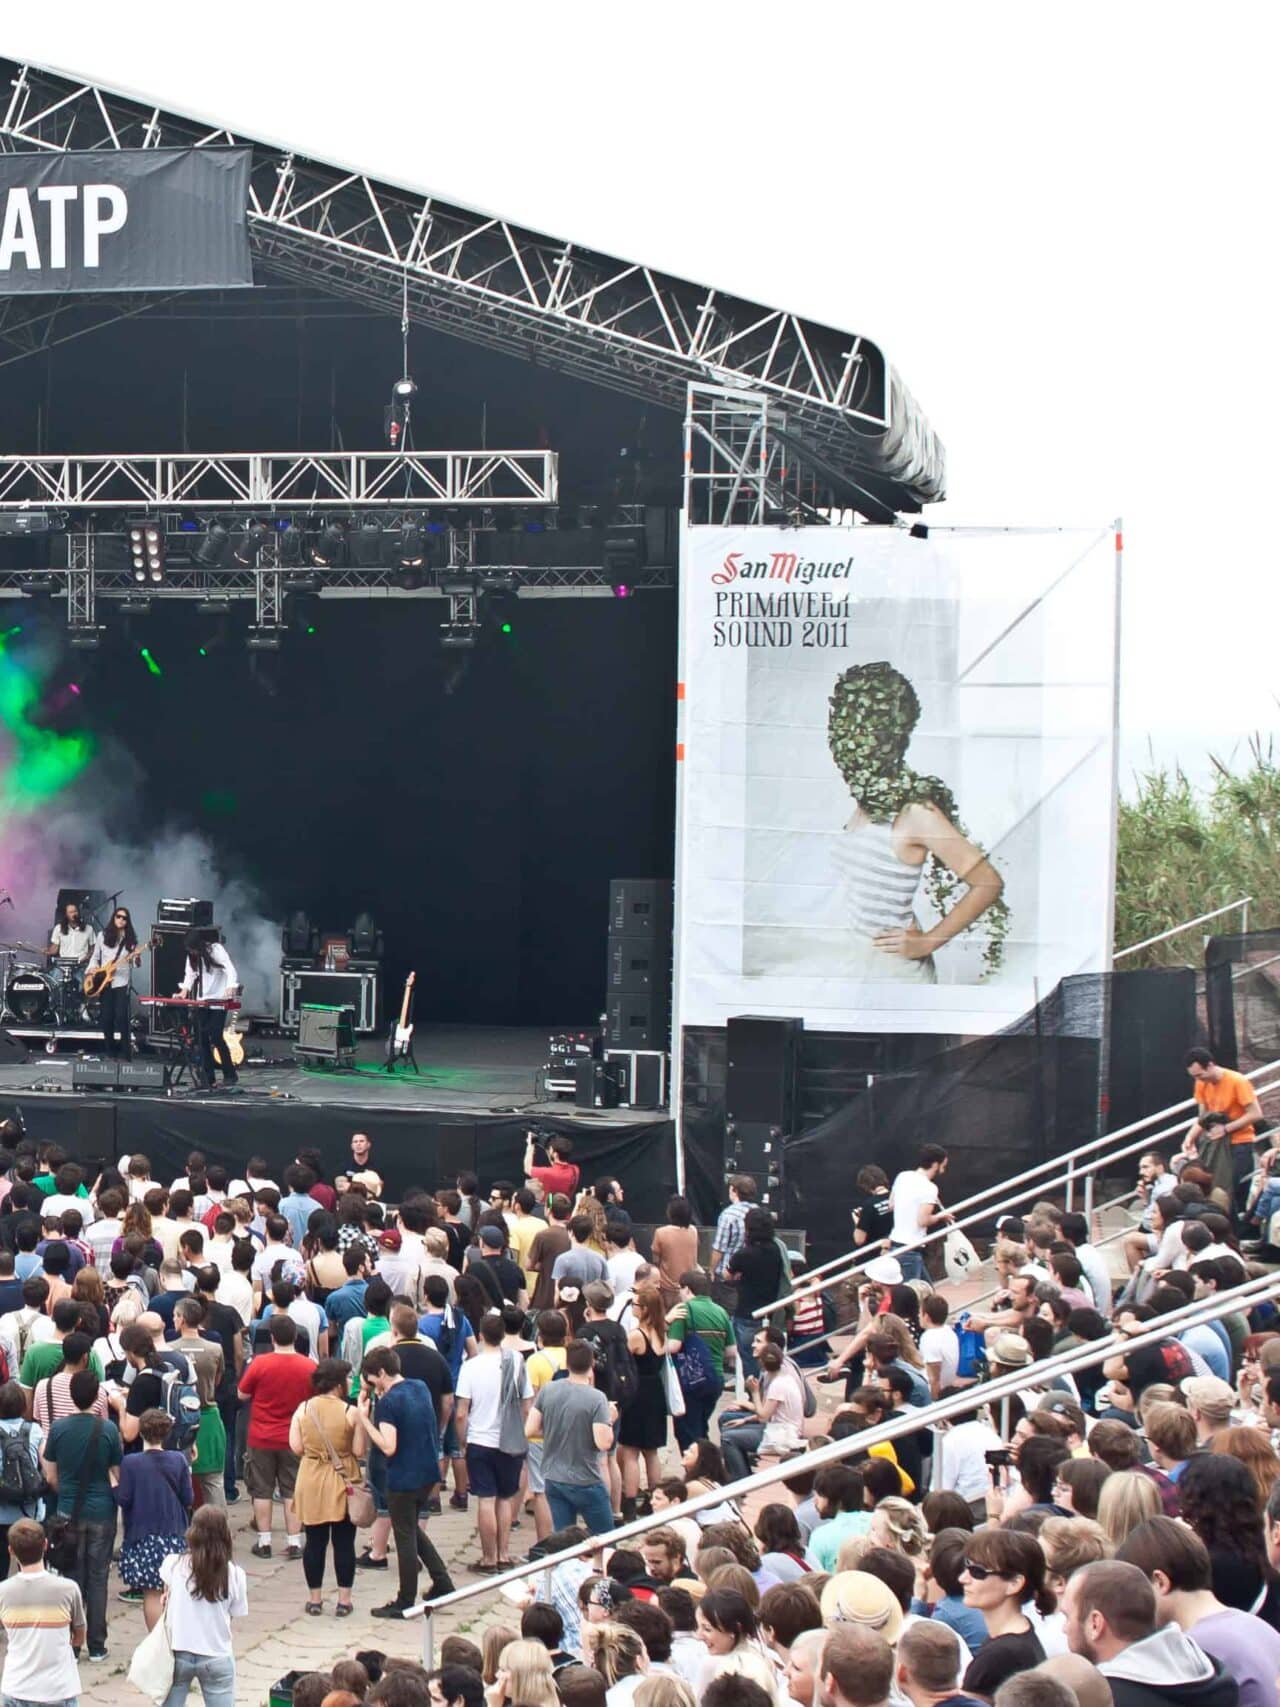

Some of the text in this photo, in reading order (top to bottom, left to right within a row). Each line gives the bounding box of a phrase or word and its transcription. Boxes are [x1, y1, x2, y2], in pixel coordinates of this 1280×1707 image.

[714, 591, 852, 618] PRIMAVERA
[713, 620, 849, 648] SOUND 2011
